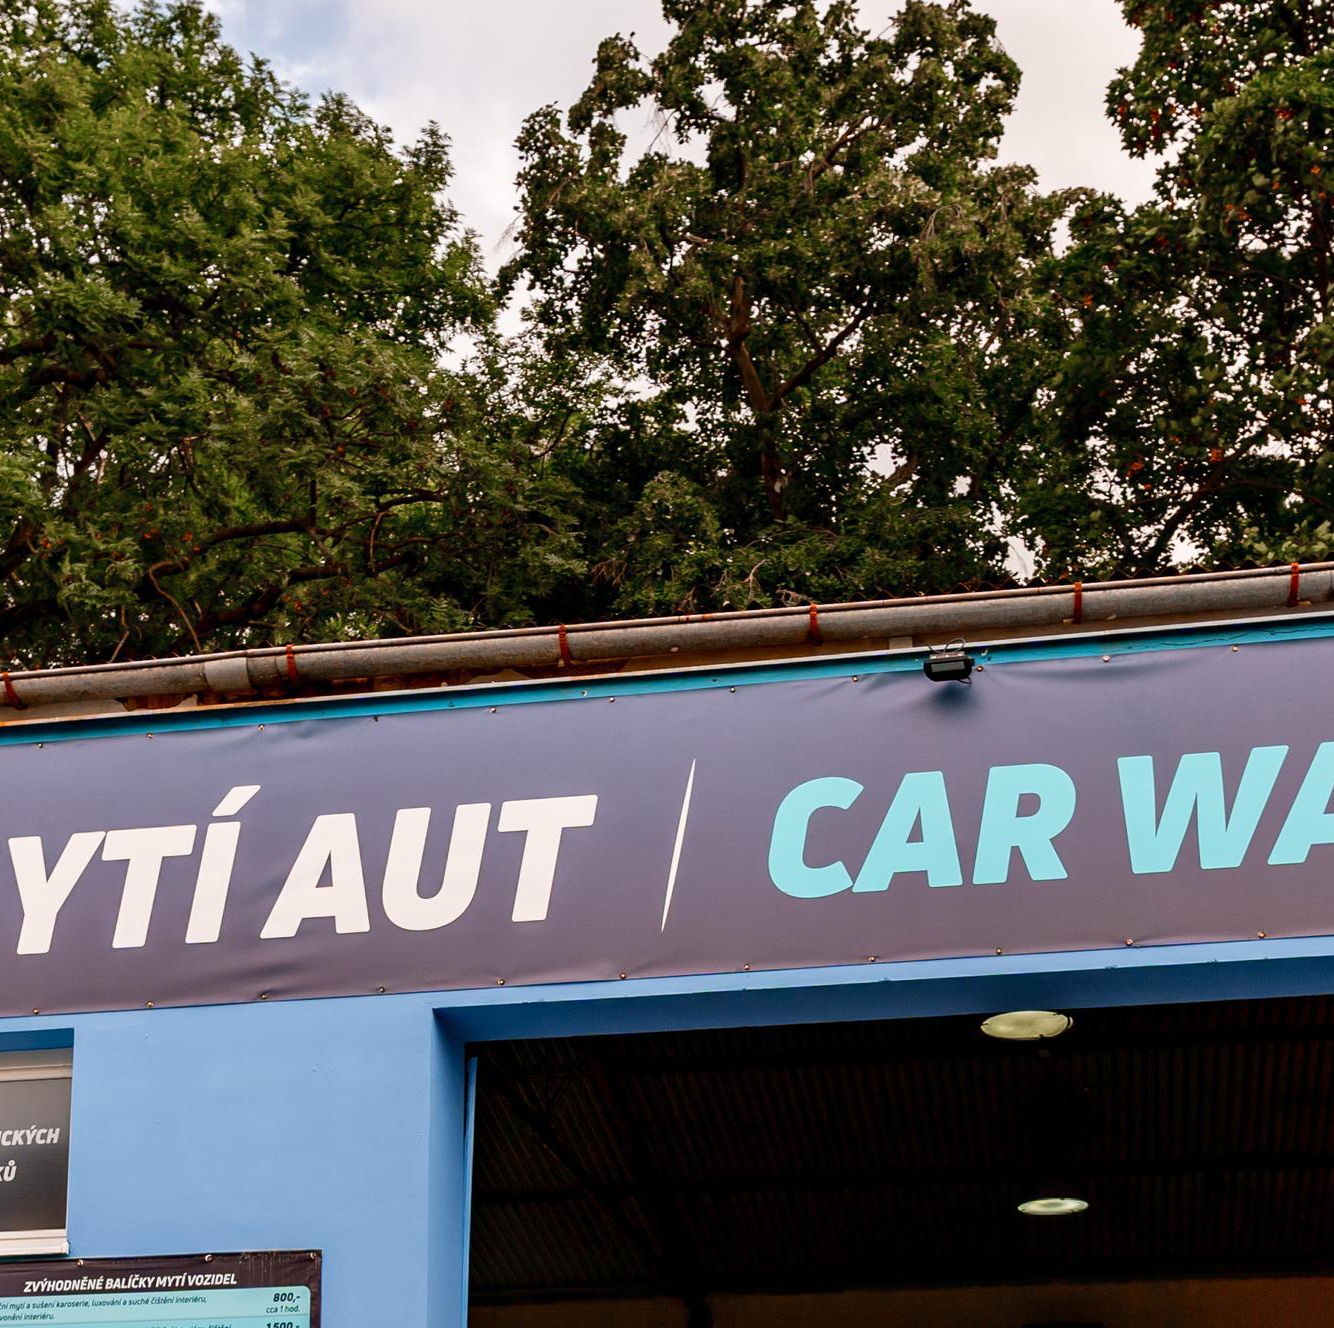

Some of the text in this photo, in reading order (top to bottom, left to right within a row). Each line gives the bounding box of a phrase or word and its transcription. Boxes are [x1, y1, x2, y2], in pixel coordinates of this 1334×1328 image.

[768, 763, 1076, 899] CAR
[260, 795, 598, 938] AUT
[23, 1272, 237, 1293] ZVÝHODNĚNÉ BALÍČKY MYTÍ VOZIDEL
[8, 1302, 26, 1311] mytí
[32, 1300, 56, 1309] sušení
[55, 1300, 90, 1308] karoserie,
[91, 1297, 123, 1307] luxování
[128, 1296, 150, 1306] suché
[150, 1296, 175, 1305] čištění
[175, 1295, 207, 1304] interiéru,
[273, 1292, 301, 1303] 800,-
[23, 1312, 55, 1321] interiéru.
[265, 1304, 300, 1314] cca 1 hod.
